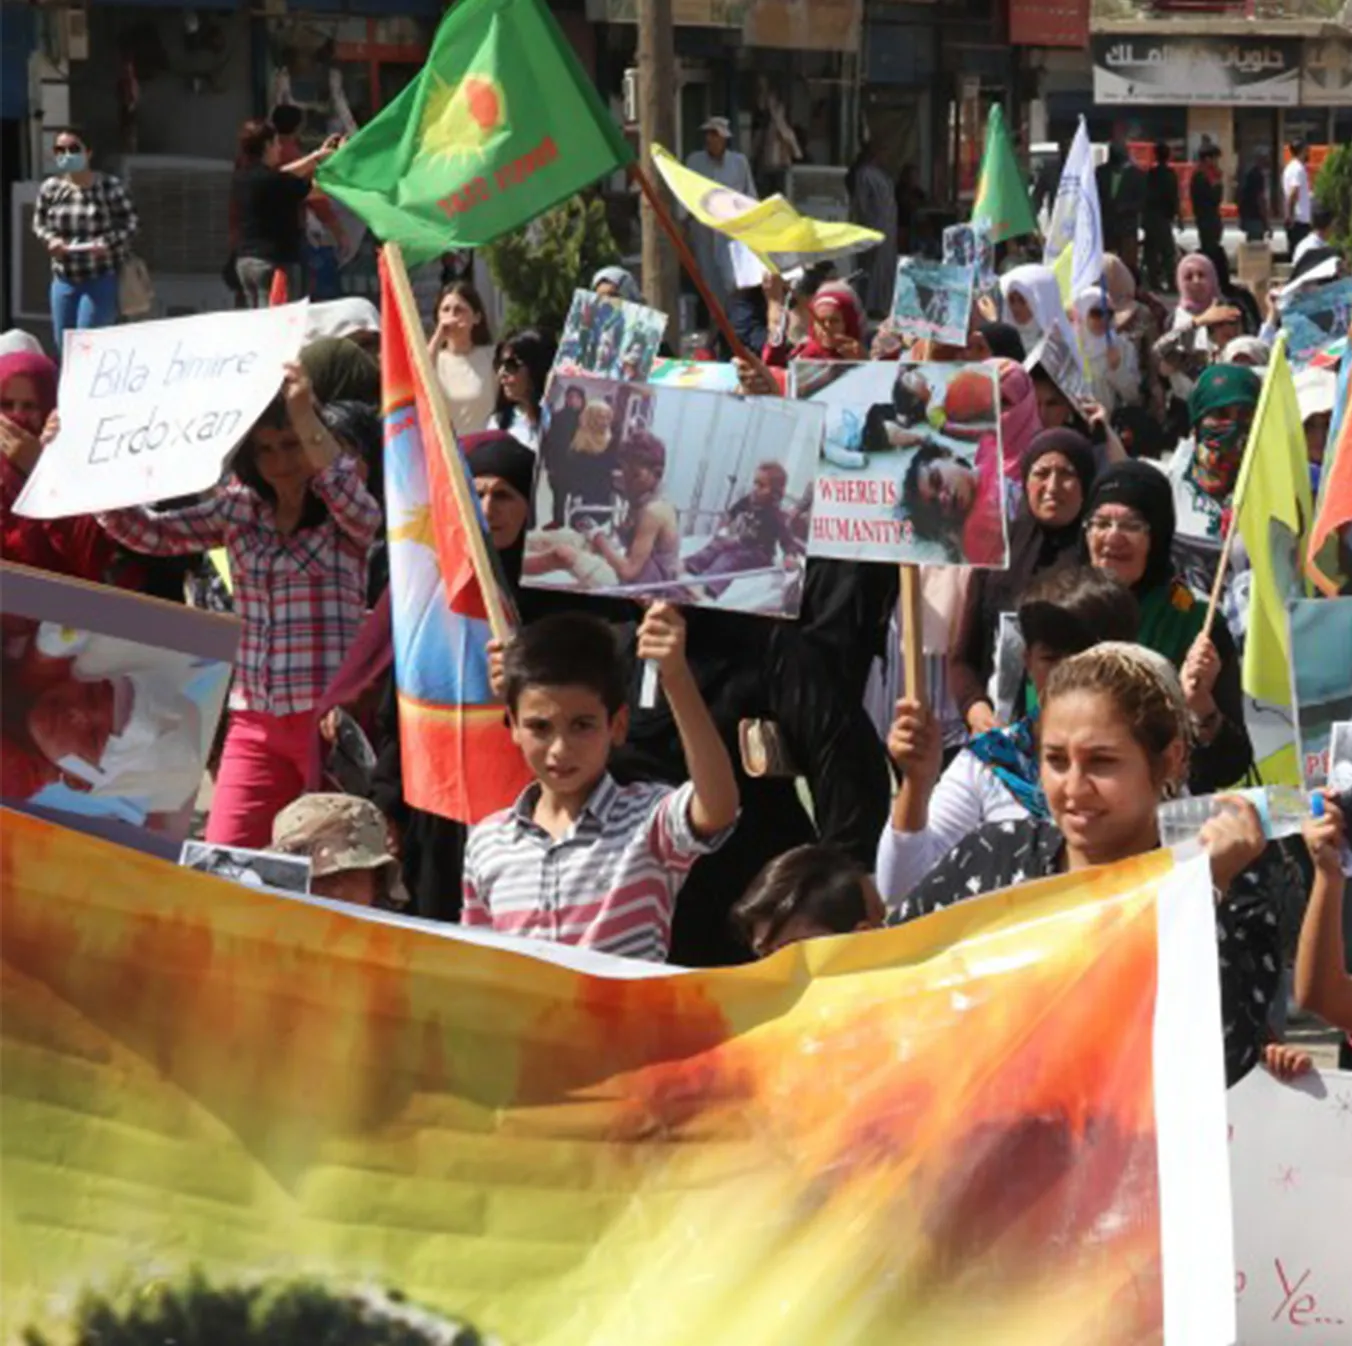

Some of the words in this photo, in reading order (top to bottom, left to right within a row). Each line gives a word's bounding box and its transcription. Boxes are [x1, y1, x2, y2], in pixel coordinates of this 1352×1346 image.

[88, 405, 242, 464] Erdoxan
[819, 478, 879, 505] WHERE
[881, 481, 896, 506] IS
[812, 517, 913, 545] HUMANITY?
